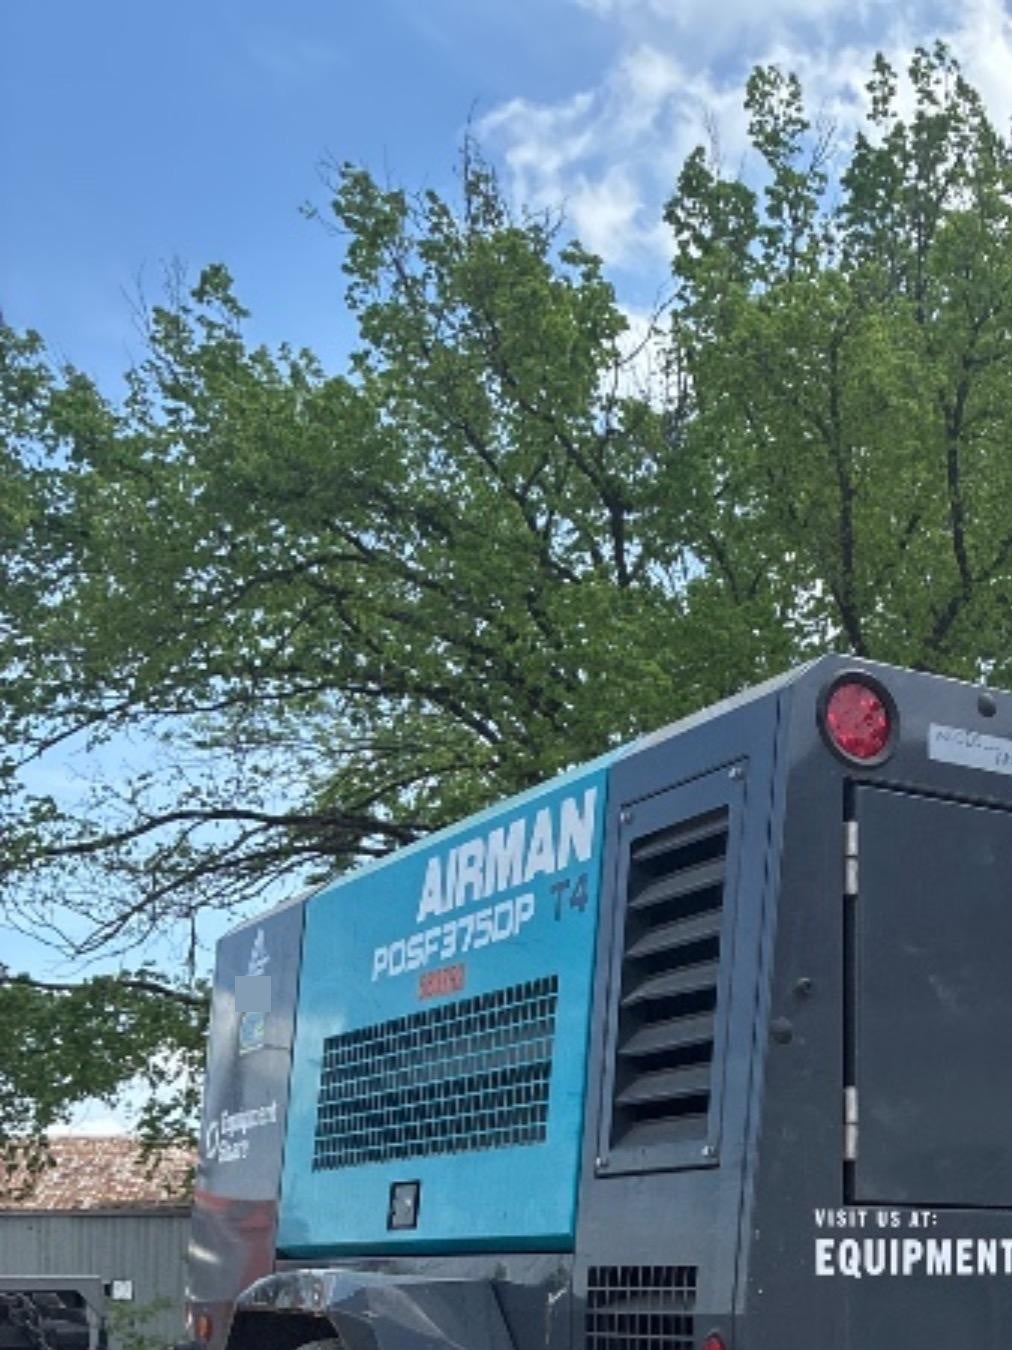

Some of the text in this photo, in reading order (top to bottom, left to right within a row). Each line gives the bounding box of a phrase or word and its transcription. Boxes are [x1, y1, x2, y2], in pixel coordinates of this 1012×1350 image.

[416, 786, 597, 925] AIRMAN
[550, 871, 589, 921] T4
[814, 1208, 938, 1228] VISIT US AT:
